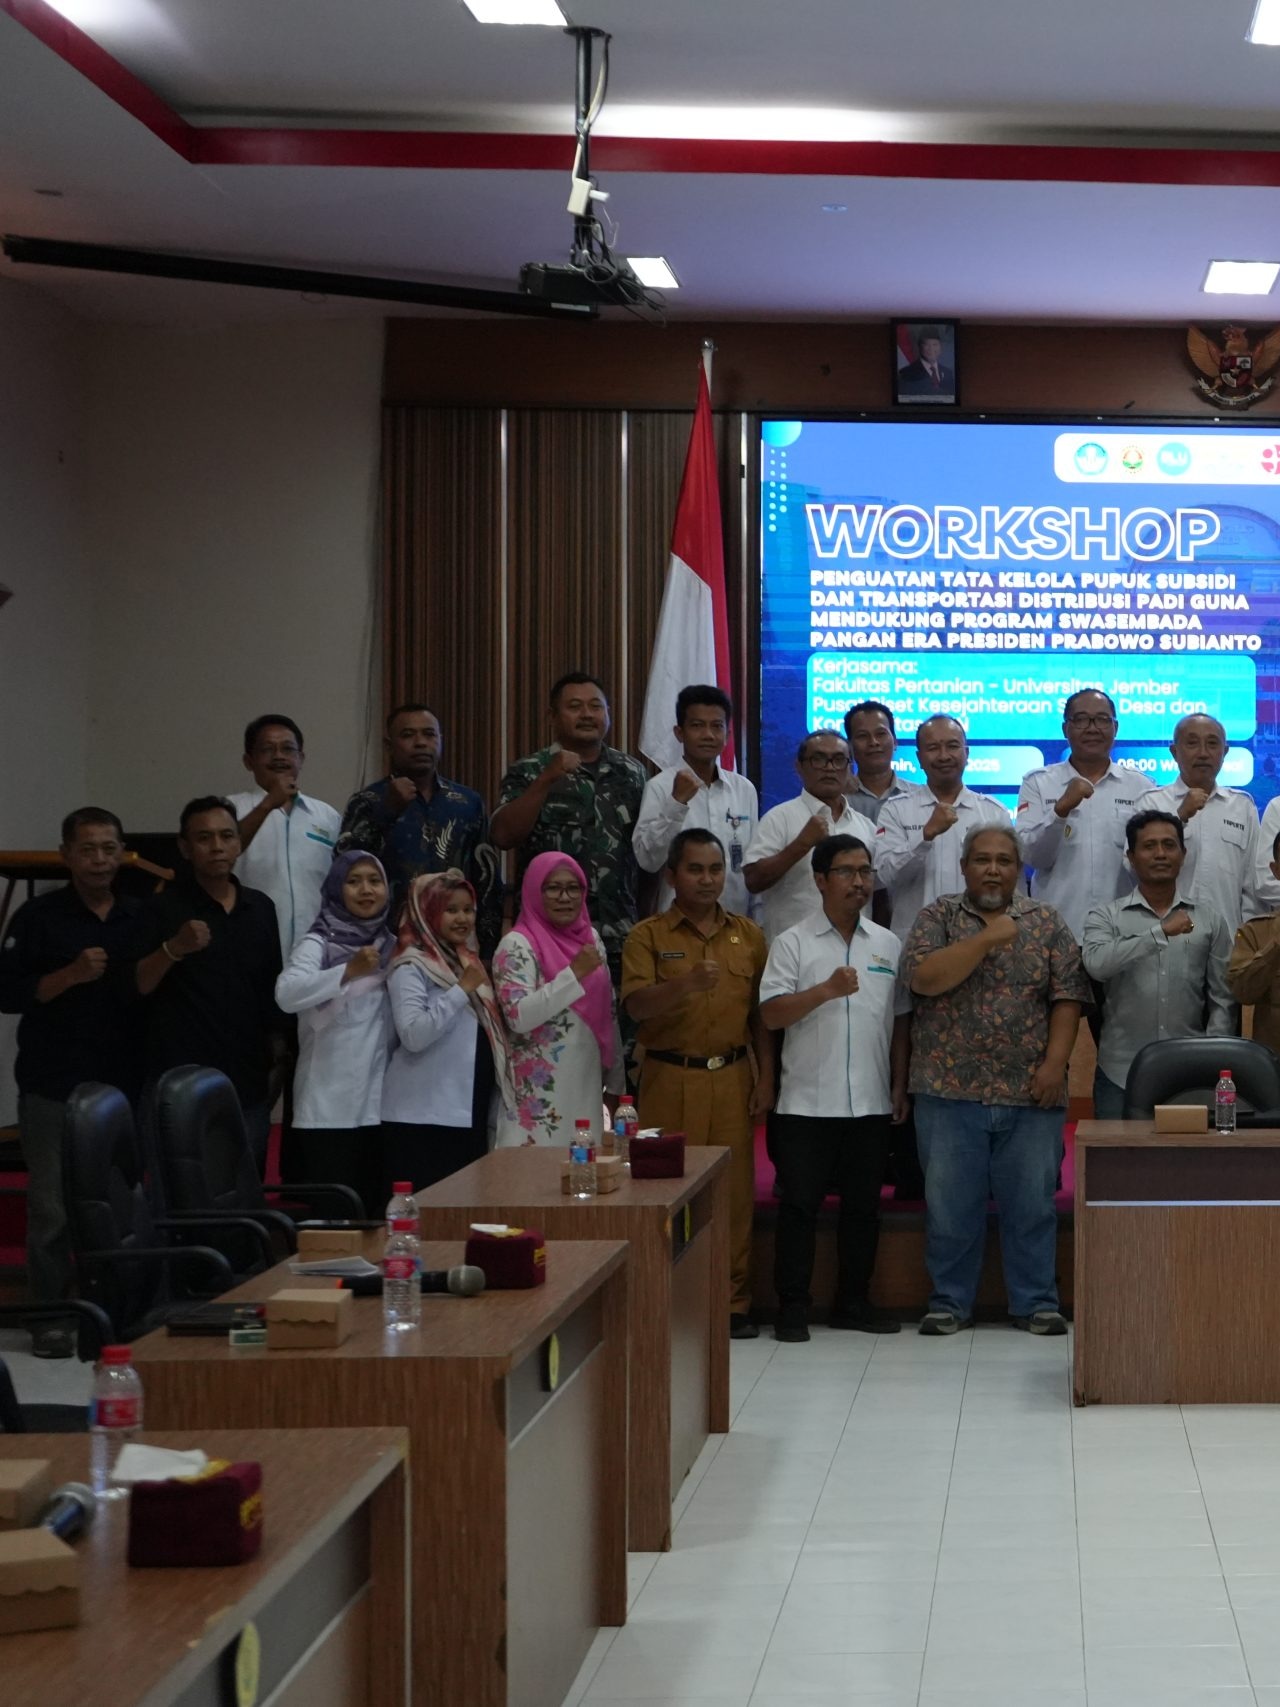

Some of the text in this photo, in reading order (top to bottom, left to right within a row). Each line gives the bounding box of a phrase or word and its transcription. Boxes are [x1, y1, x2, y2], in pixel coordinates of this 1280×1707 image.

[806, 504, 1221, 562] WORKSHOP
[810, 570, 1236, 590] PENGUATAN TATA KELOLA PUPUK SUBSIDI
[810, 590, 1250, 611] DAN TRANSPORTASI DISTRIBUSI PADI GUNA
[810, 611, 1203, 630] MENDUKUNG PROGRAM SWASEMBADA
[810, 631, 1262, 651] PANGAN ERA PRESIDEN PRABOWO SUBIANTO
[812, 657, 919, 678] Kerjasama:
[812, 677, 890, 694] Fakultas
[895, 677, 984, 694] Pertanian
[1109, 678, 1180, 696] Jember
[918, 697, 1053, 716] Kesejahteraan
[1119, 699, 1166, 715] Desa
[1169, 698, 1207, 714] dan
